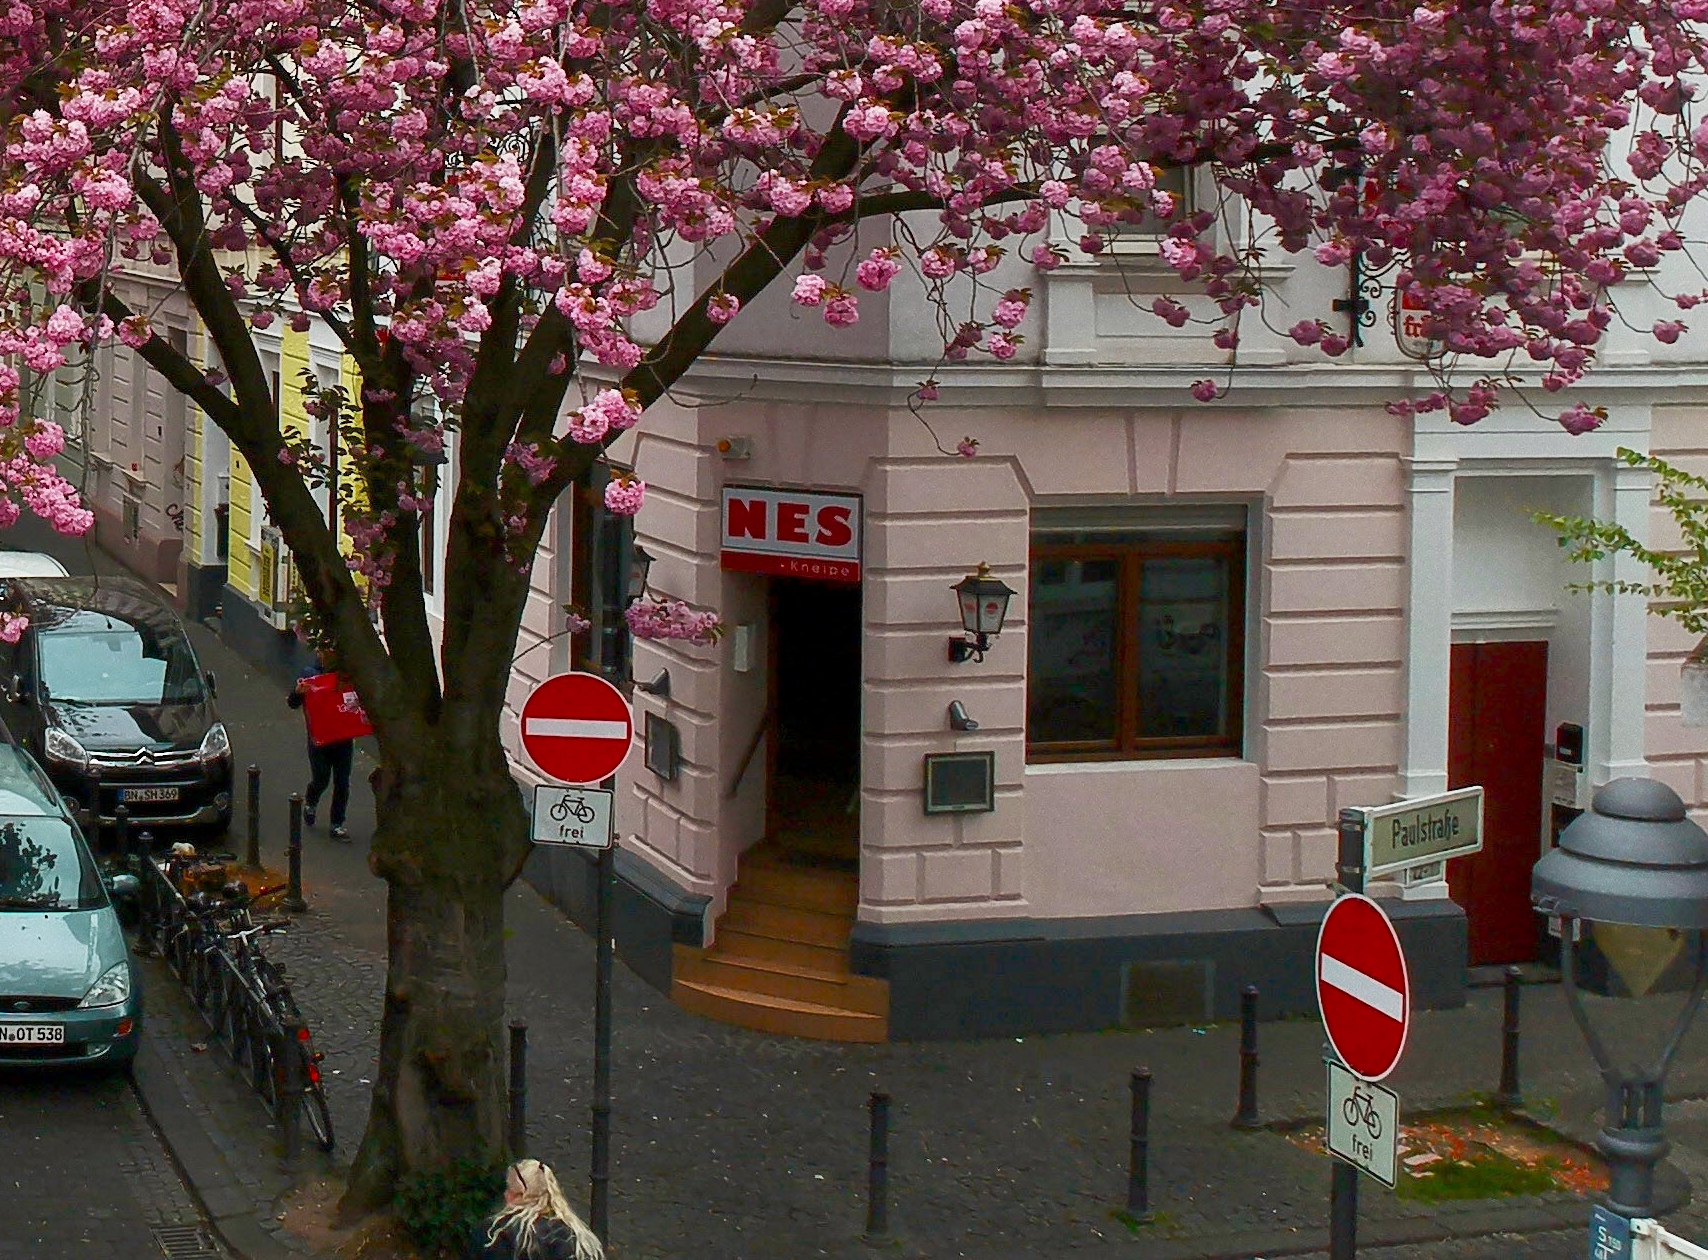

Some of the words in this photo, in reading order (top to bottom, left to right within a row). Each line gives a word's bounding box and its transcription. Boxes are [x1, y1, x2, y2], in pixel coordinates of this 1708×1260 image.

[728, 497, 852, 547] NES
[790, 560, 851, 577] Kneipe
[559, 824, 585, 839] frei
[1392, 808, 1460, 849] Paulstraße
[16, 1027, 34, 1041] OT
[36, 1027, 63, 1041] 538
[1352, 1133, 1373, 1161] frei
